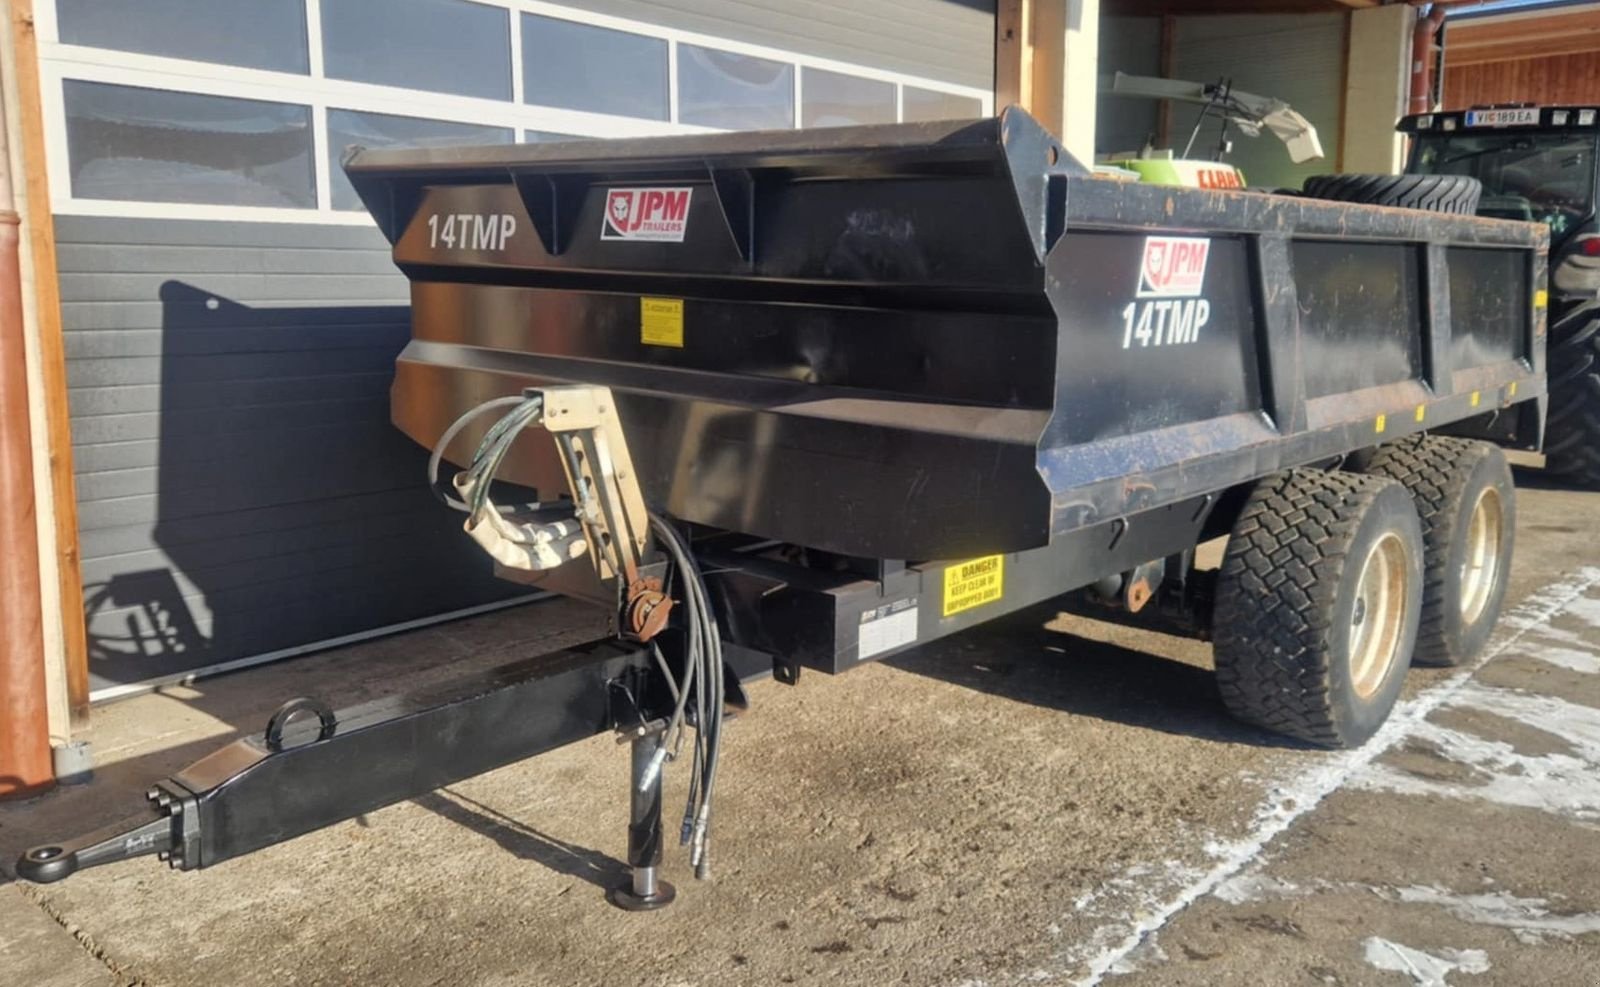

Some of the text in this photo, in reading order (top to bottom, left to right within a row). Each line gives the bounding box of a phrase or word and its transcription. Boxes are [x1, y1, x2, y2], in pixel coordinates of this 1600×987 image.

[630, 191, 689, 231] JPM
[642, 222, 682, 233] TRAILERS
[427, 213, 517, 251] 14TMP
[1163, 242, 1207, 286] JPM
[1122, 299, 1210, 349] 14TMP
[962, 557, 998, 578] DANGER
